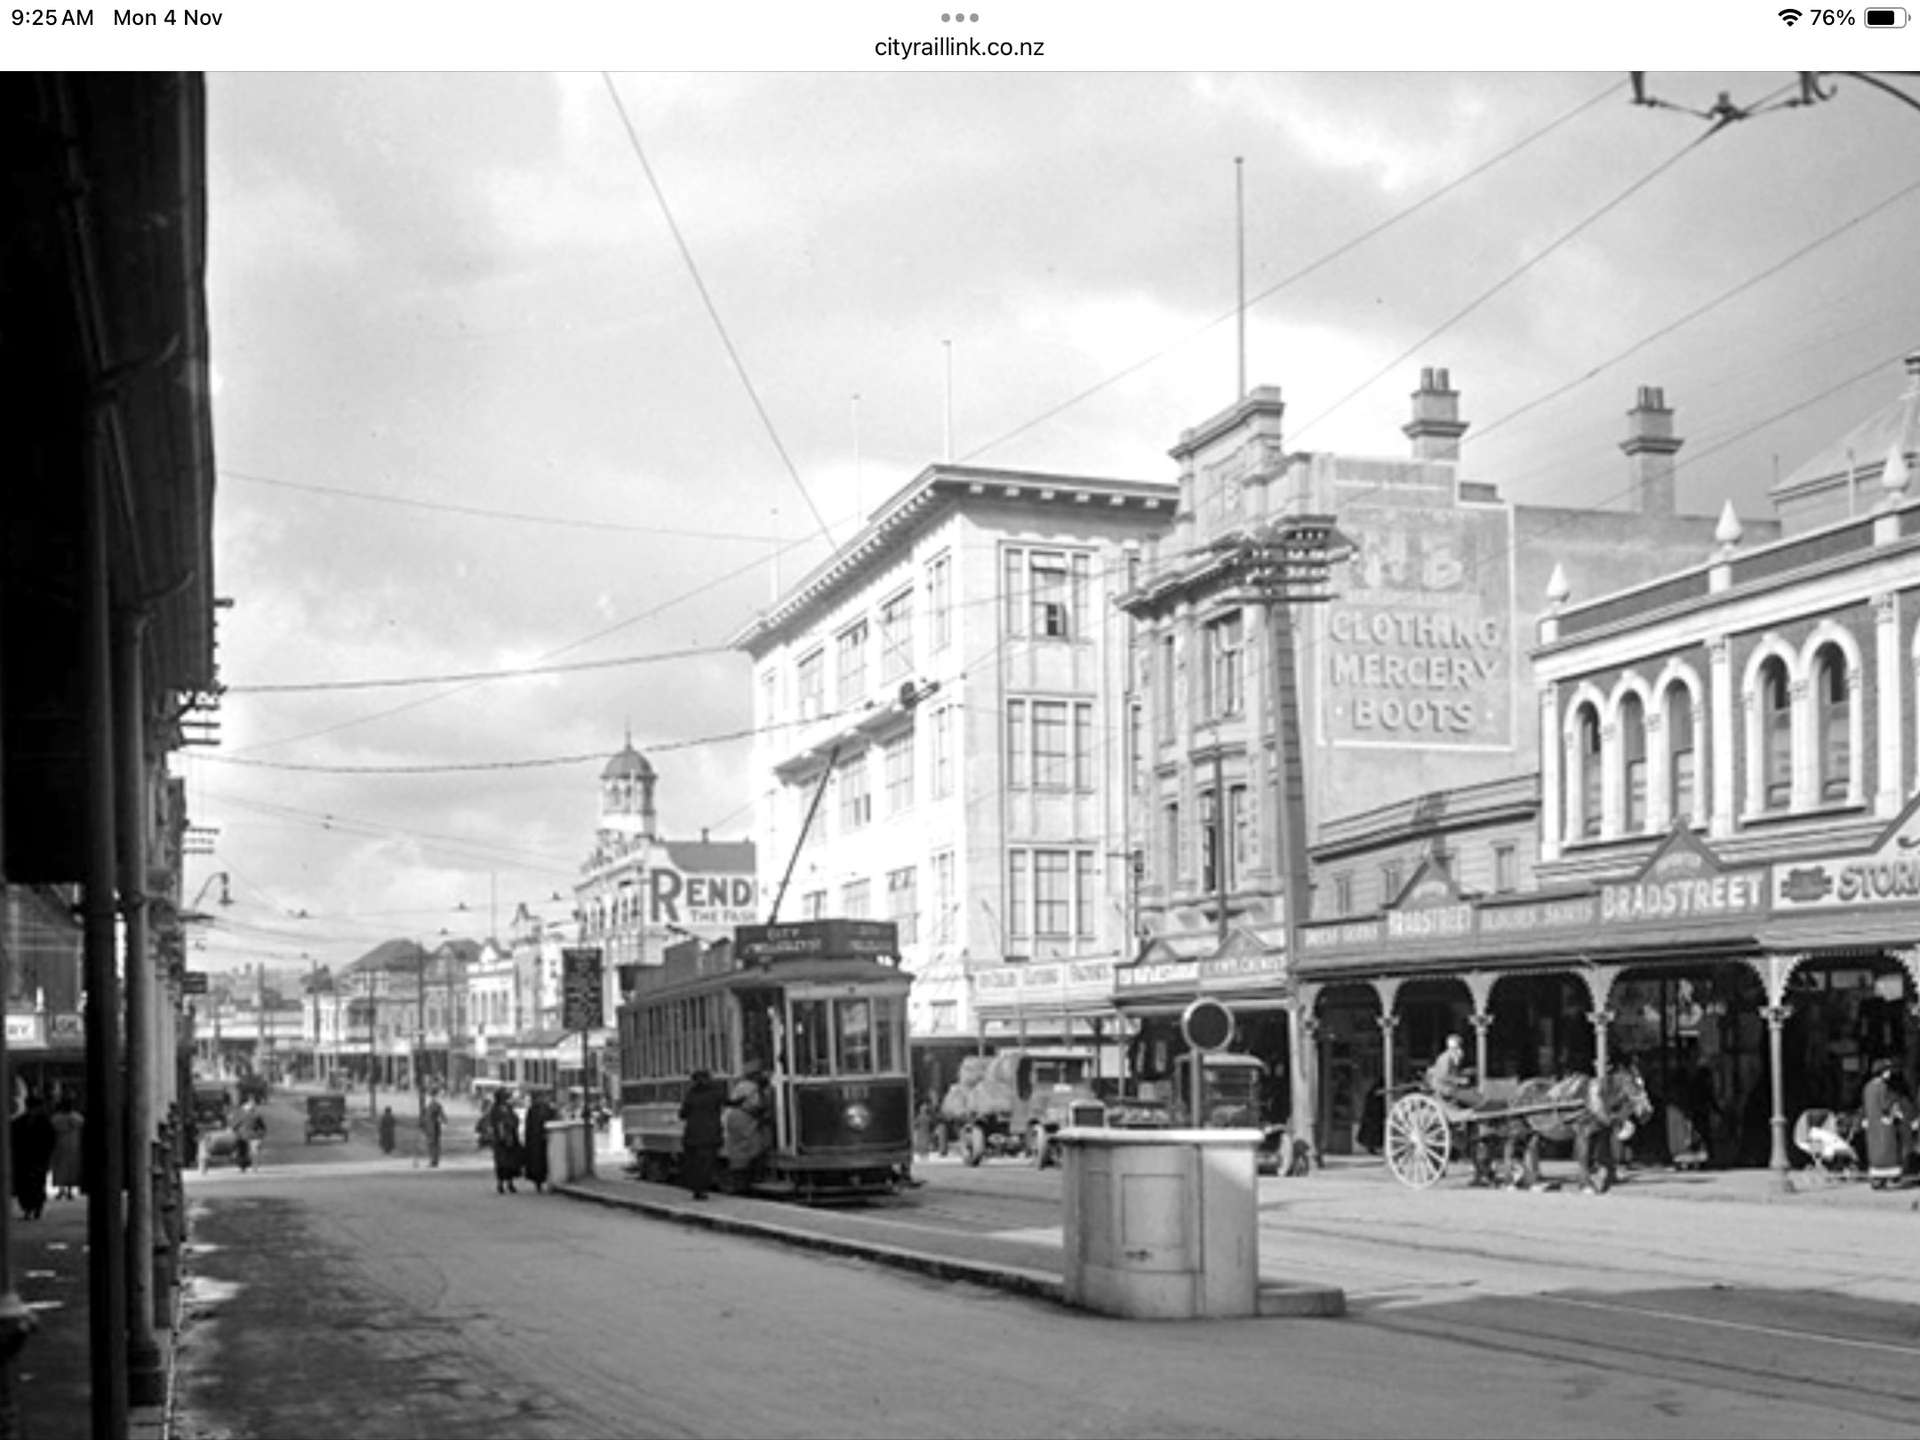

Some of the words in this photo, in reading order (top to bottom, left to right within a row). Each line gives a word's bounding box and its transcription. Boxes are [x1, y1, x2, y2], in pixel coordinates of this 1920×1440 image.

[1330, 610, 1501, 651] CLOTHING
[1330, 653, 1501, 691] MERCERY
[1353, 699, 1475, 733] BOOTS
[651, 868, 758, 922] REND
[1602, 870, 1766, 921] BRADSTREET
[1837, 860, 1920, 902] STOR
